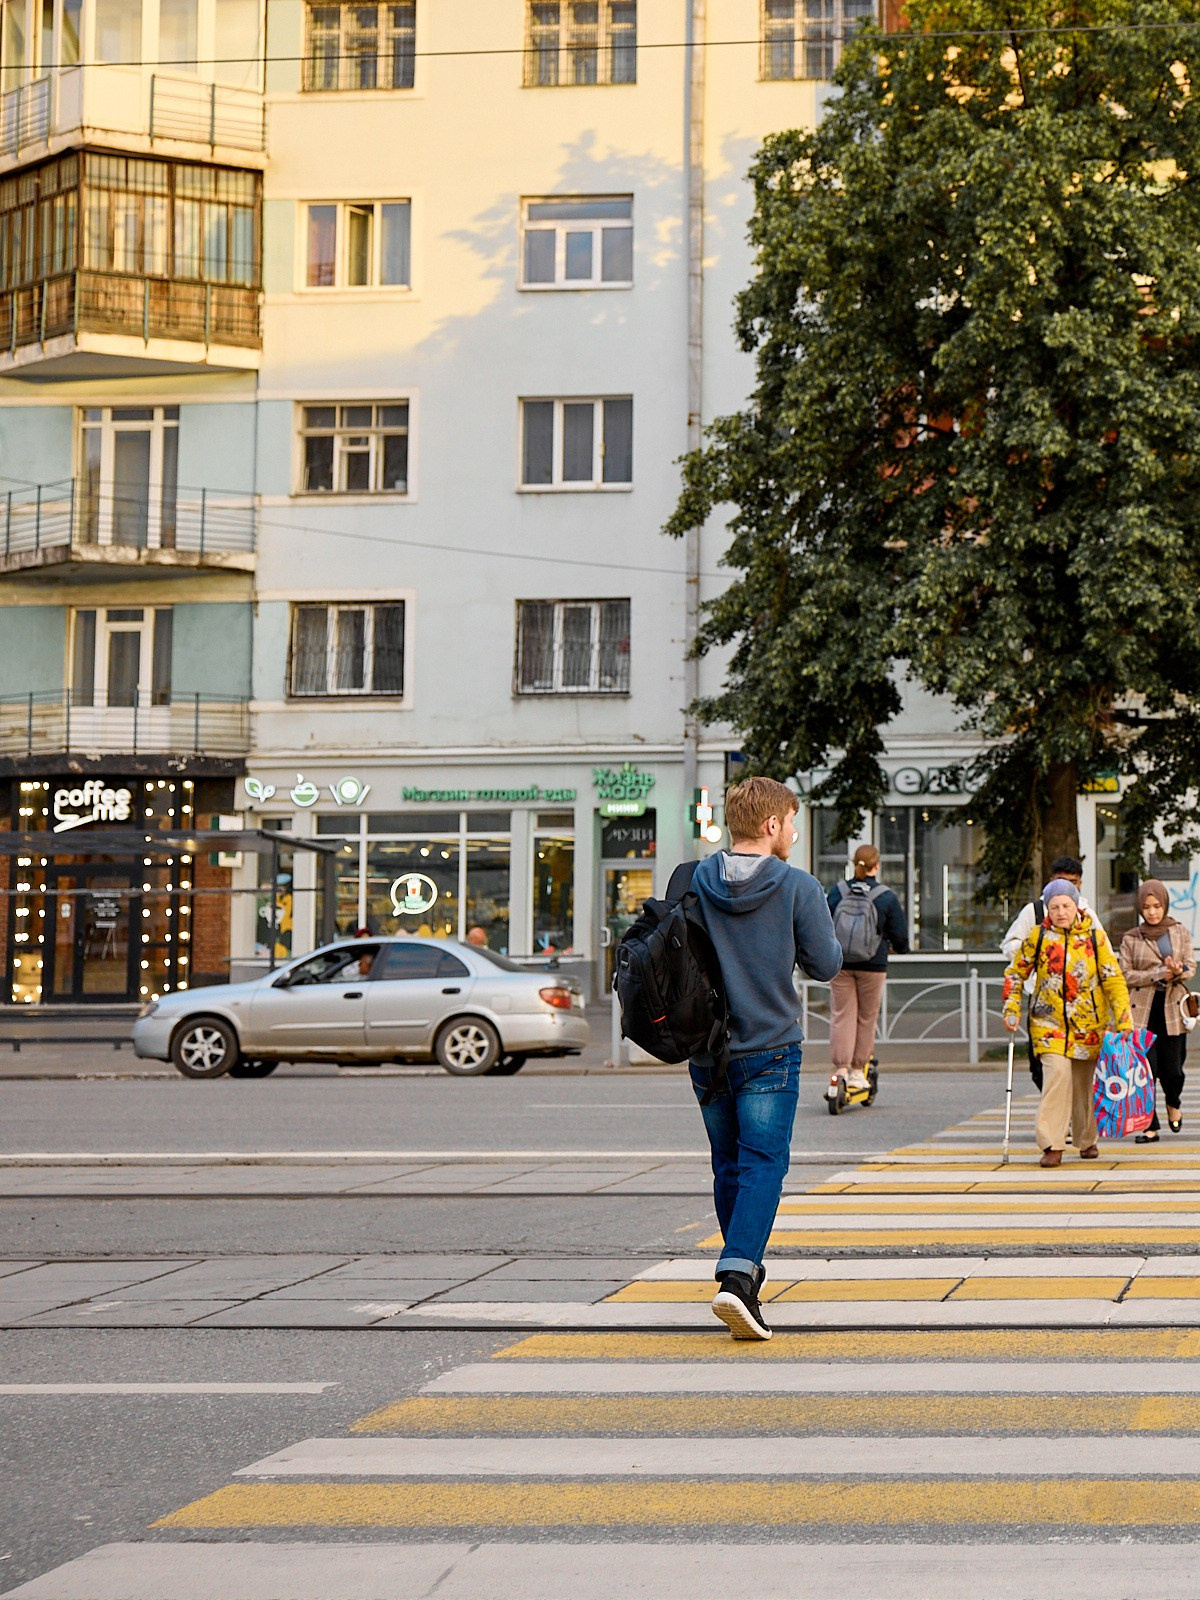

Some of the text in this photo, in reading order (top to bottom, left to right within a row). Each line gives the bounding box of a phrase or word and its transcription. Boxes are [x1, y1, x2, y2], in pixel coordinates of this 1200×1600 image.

[54, 780, 132, 807] coffee
[402, 784, 577, 802] Магазин готовой еды
[93, 803, 131, 821] me
